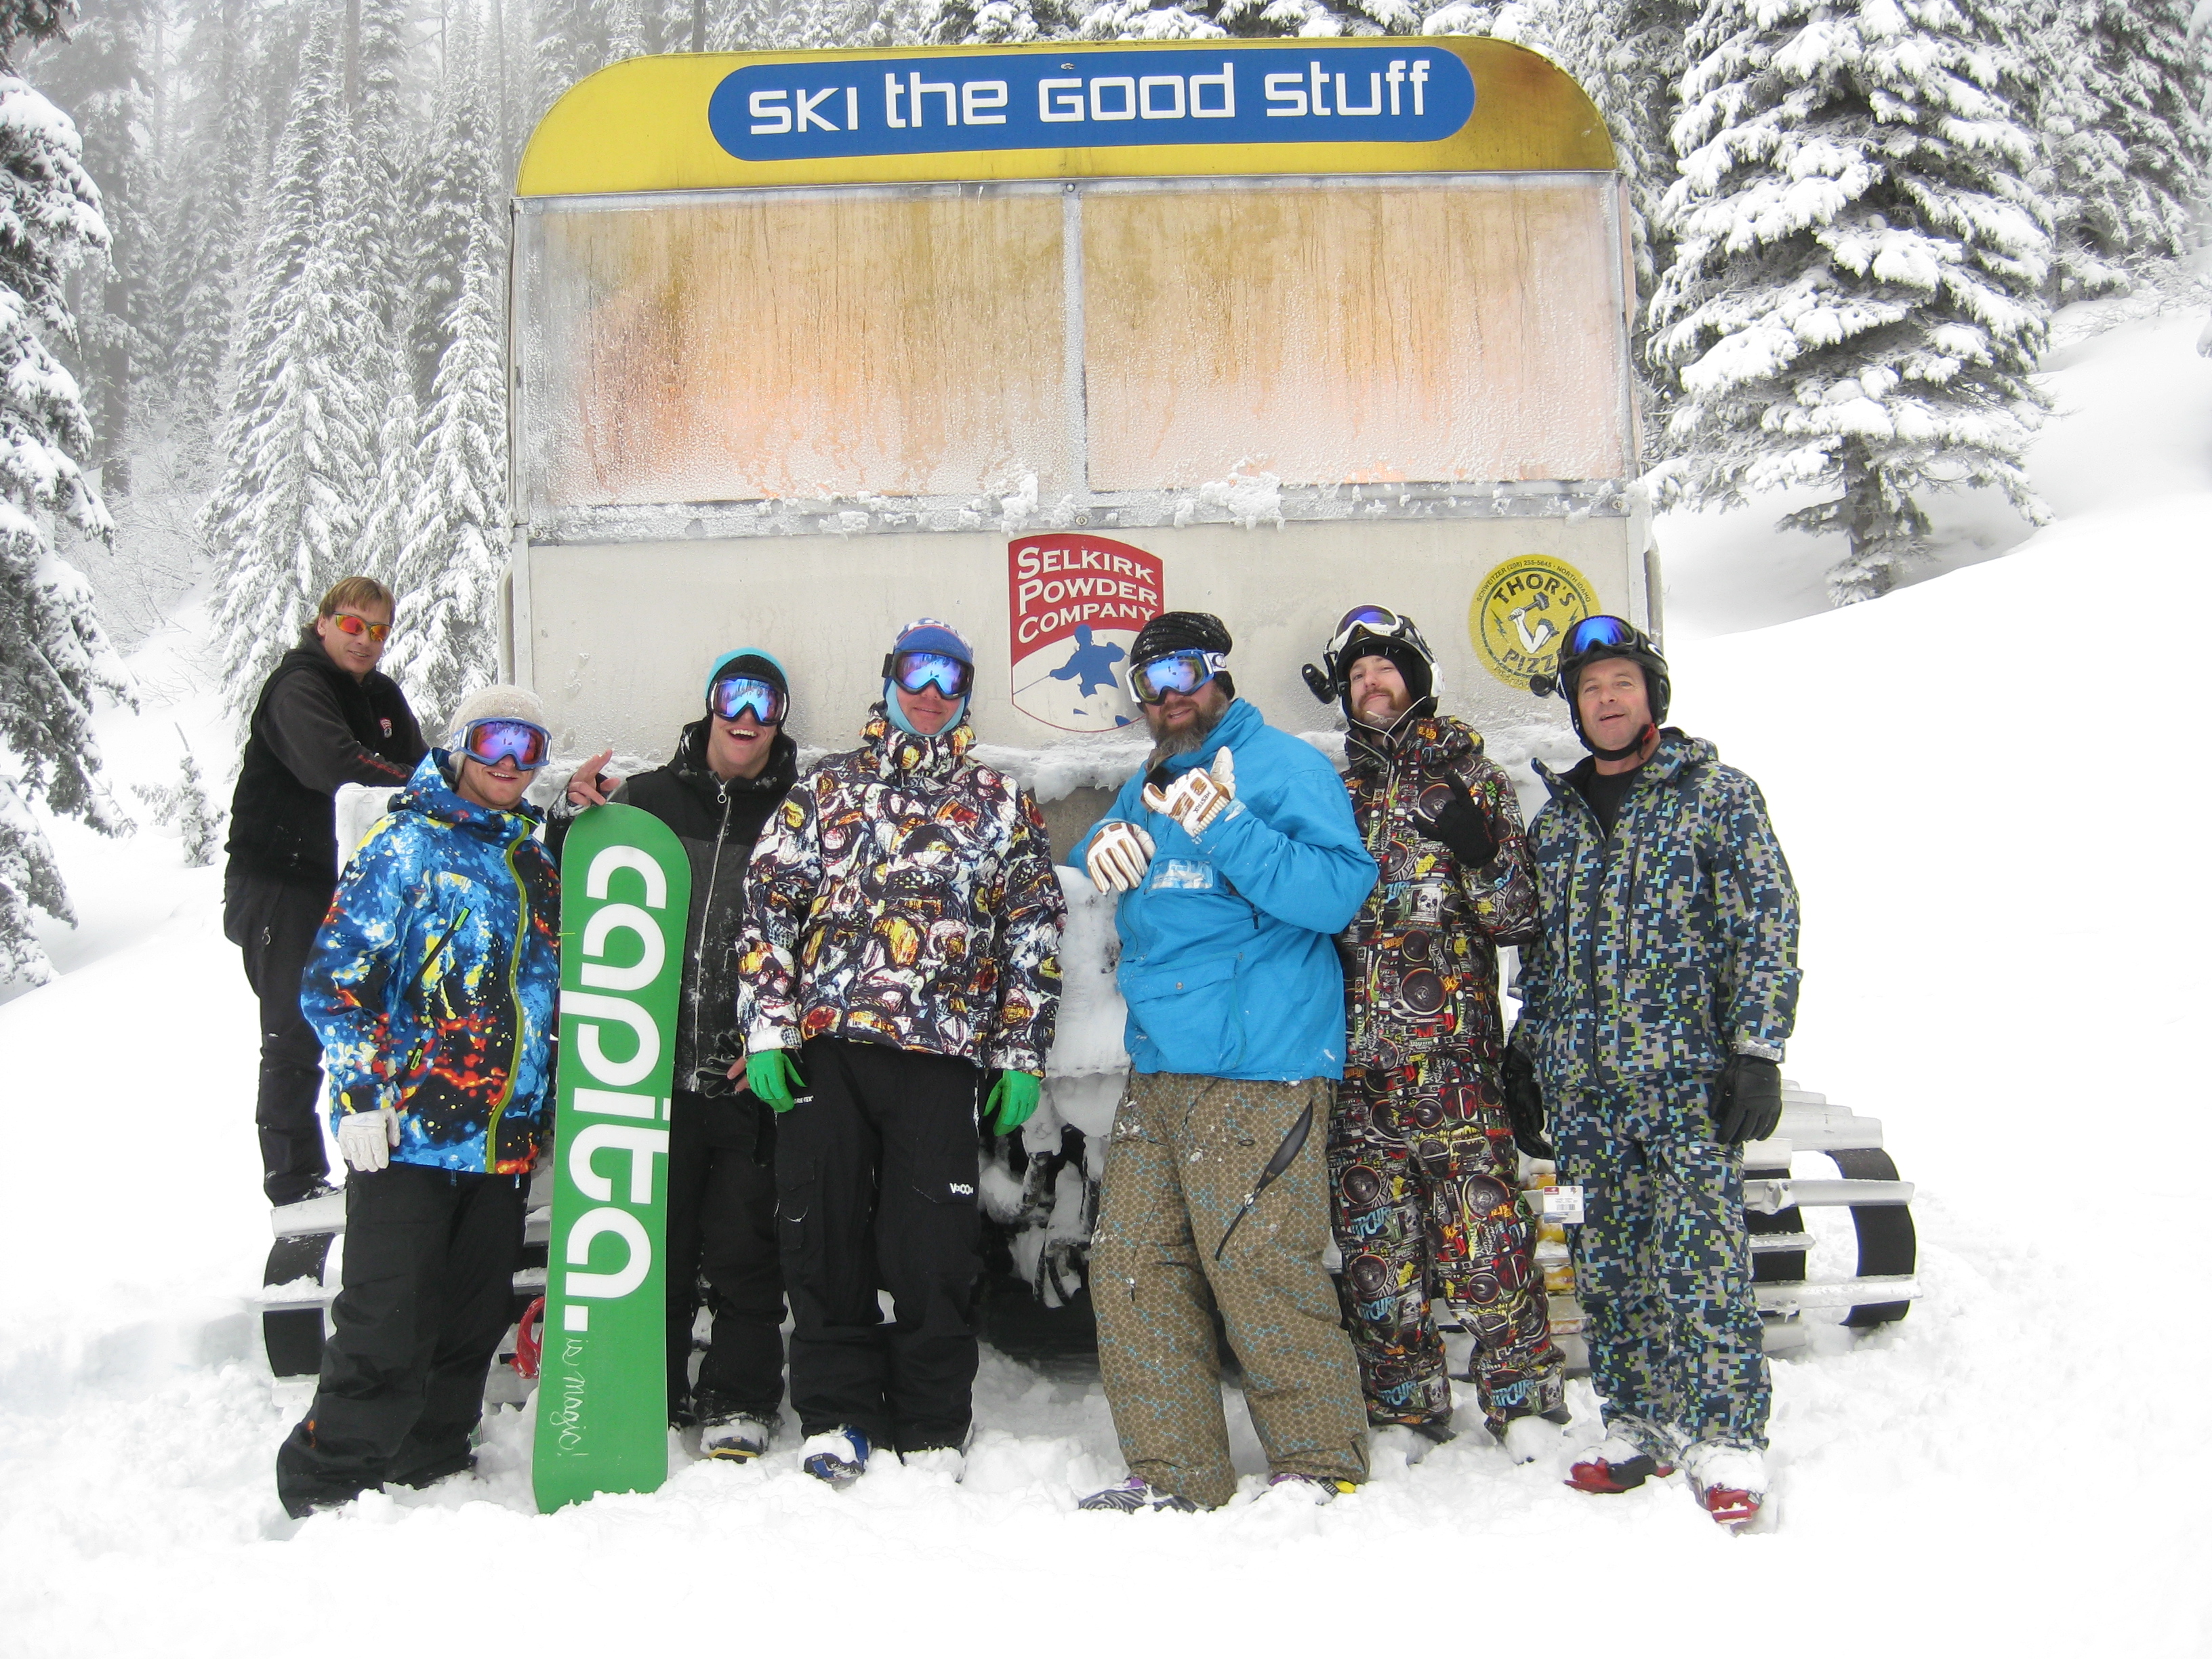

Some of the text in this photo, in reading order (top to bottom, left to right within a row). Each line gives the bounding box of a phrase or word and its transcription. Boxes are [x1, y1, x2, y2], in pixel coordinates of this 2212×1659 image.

[884, 72, 1008, 128] the
[1265, 60, 1431, 117] stuff
[1017, 546, 1155, 586] SELKIRK
[1557, 565, 1578, 583] NORTH
[1576, 581, 1592, 603] IDAHO
[1019, 577, 1158, 617] POWDER
[1492, 573, 1576, 607] THOR'S
[1019, 602, 1155, 644] COMPANY
[1502, 648, 1561, 674] PIZZ
